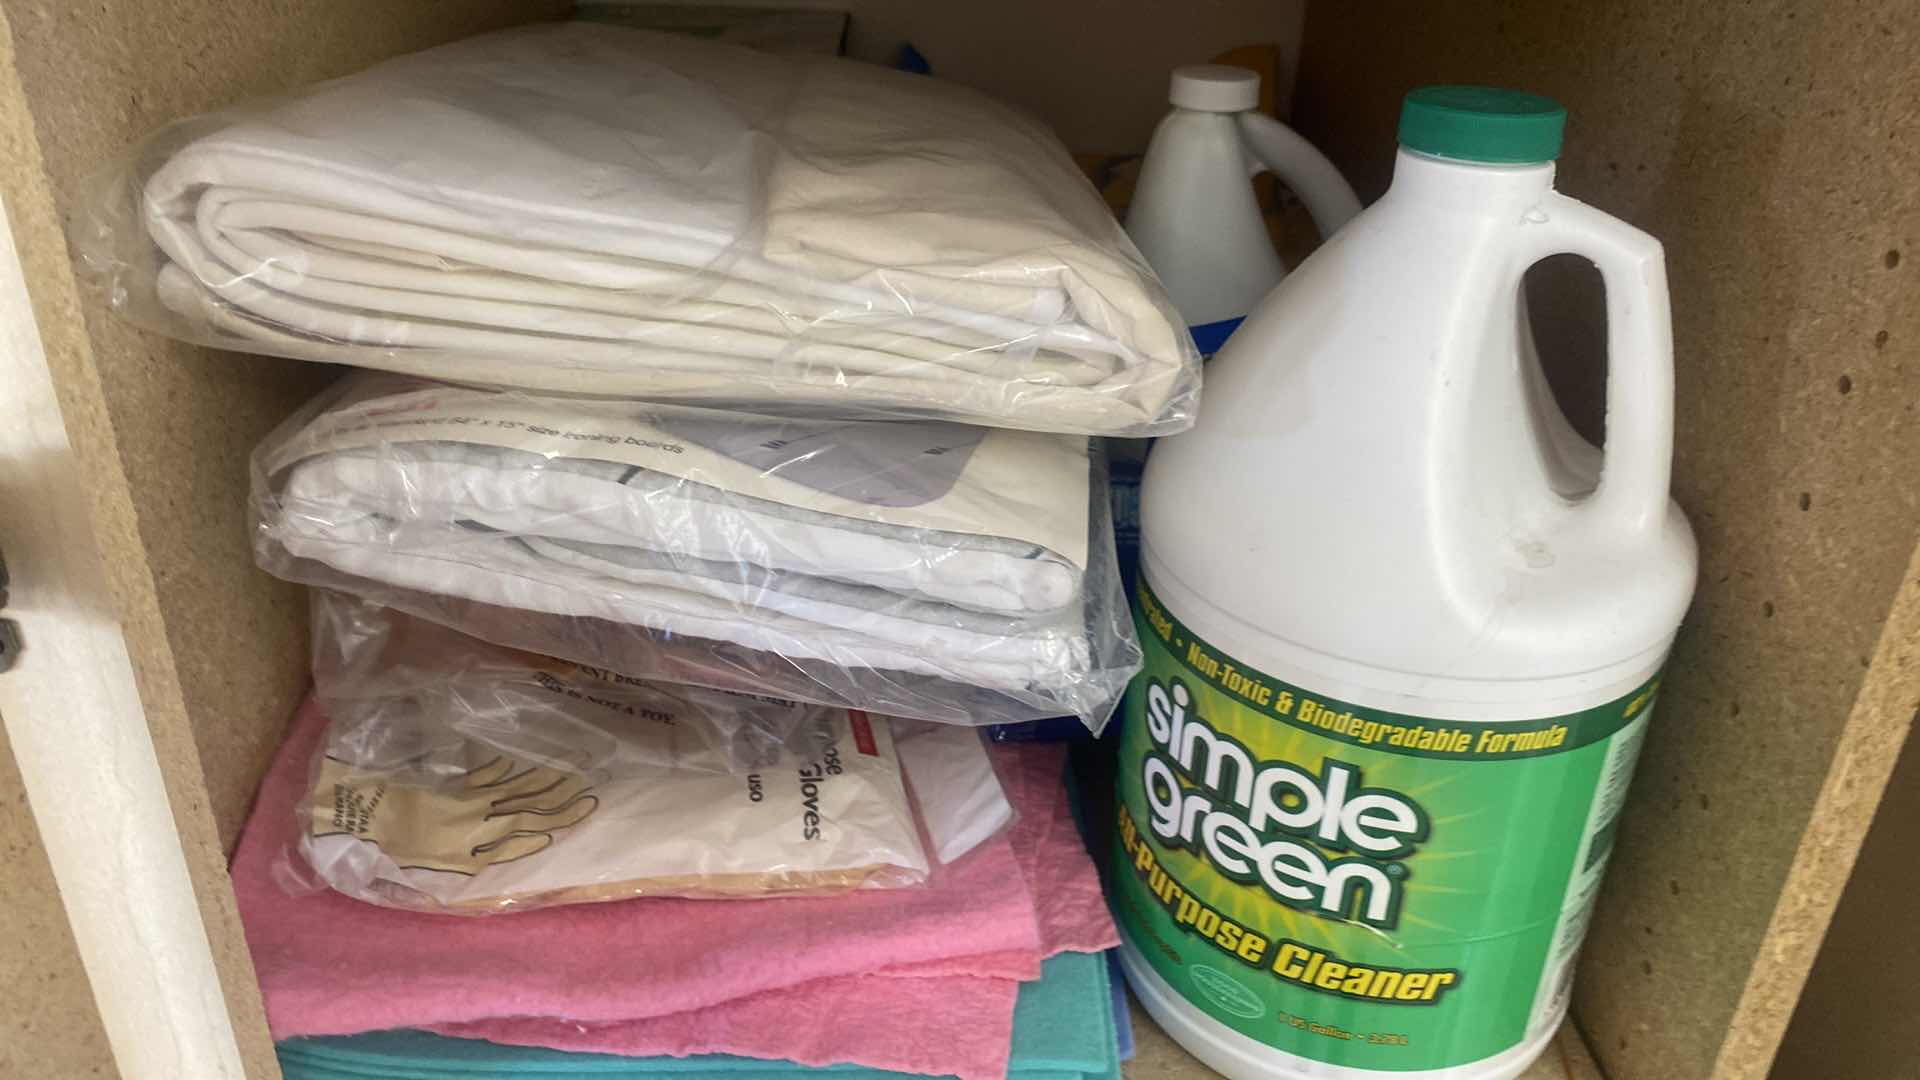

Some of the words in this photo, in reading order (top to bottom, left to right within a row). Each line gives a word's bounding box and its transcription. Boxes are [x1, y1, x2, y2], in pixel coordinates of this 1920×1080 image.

[563, 430, 621, 444] ironing
[624, 435, 686, 455] boards
[1187, 641, 1272, 706] Non-Toxic
[1274, 689, 1296, 716] &
[1296, 697, 1472, 753] Biodegradable
[1475, 722, 1569, 754] Formula
[798, 763, 825, 841] Gloves
[1147, 683, 1419, 852] simple
[1143, 757, 1393, 921] green
[1272, 943, 1456, 1001] Cleaner
